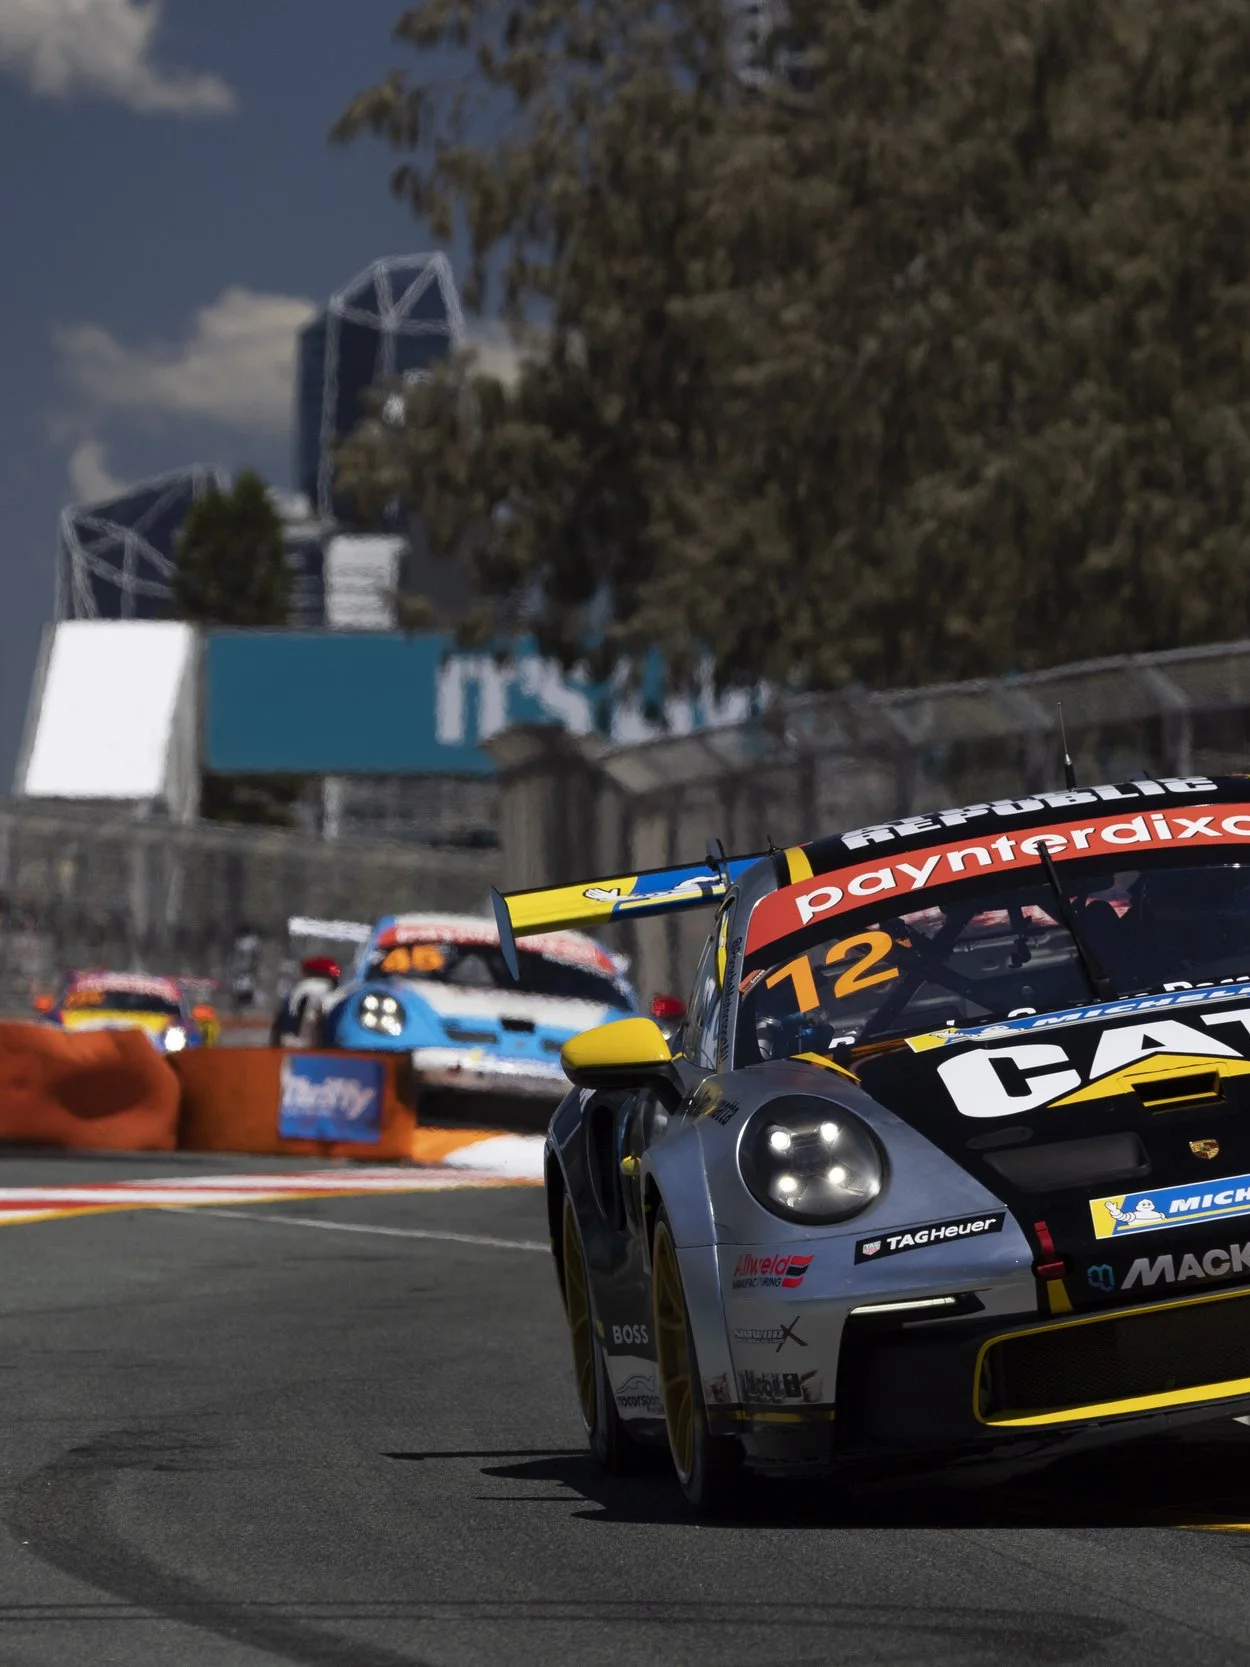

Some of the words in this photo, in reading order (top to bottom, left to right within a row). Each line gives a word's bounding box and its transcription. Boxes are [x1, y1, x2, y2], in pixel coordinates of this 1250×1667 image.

[841, 776, 1218, 850] REPUBLIC
[765, 930, 899, 1013] 12
[734, 1253, 792, 1277] Allweld
[612, 1325, 649, 1344] BOSS
